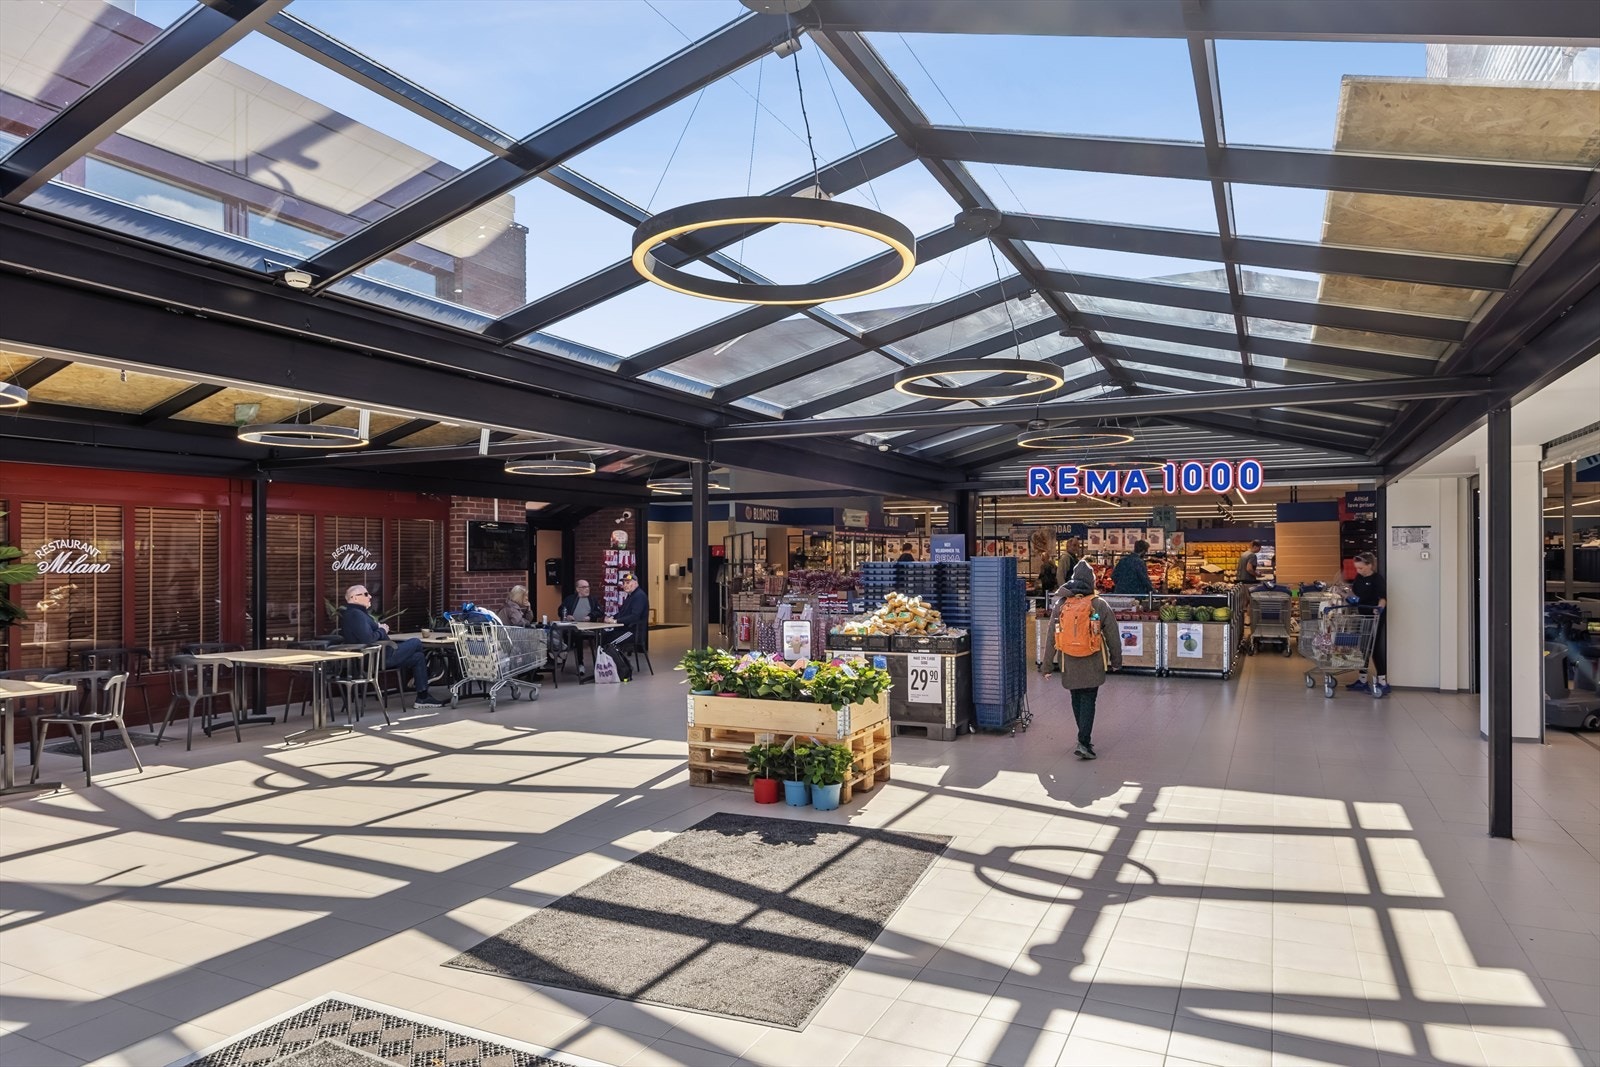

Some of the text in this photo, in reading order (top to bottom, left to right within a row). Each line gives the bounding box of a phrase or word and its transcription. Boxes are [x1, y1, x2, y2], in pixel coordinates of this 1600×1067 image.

[1028, 460, 1263, 497] REMA 1000
[753, 507, 779, 522] BLOMSTER
[34, 539, 102, 559] RESTAURANT
[331, 544, 372, 559] RESTAURANT
[36, 551, 111, 575] Milano
[331, 553, 377, 571] Milano
[910, 669, 939, 691] 29 90
